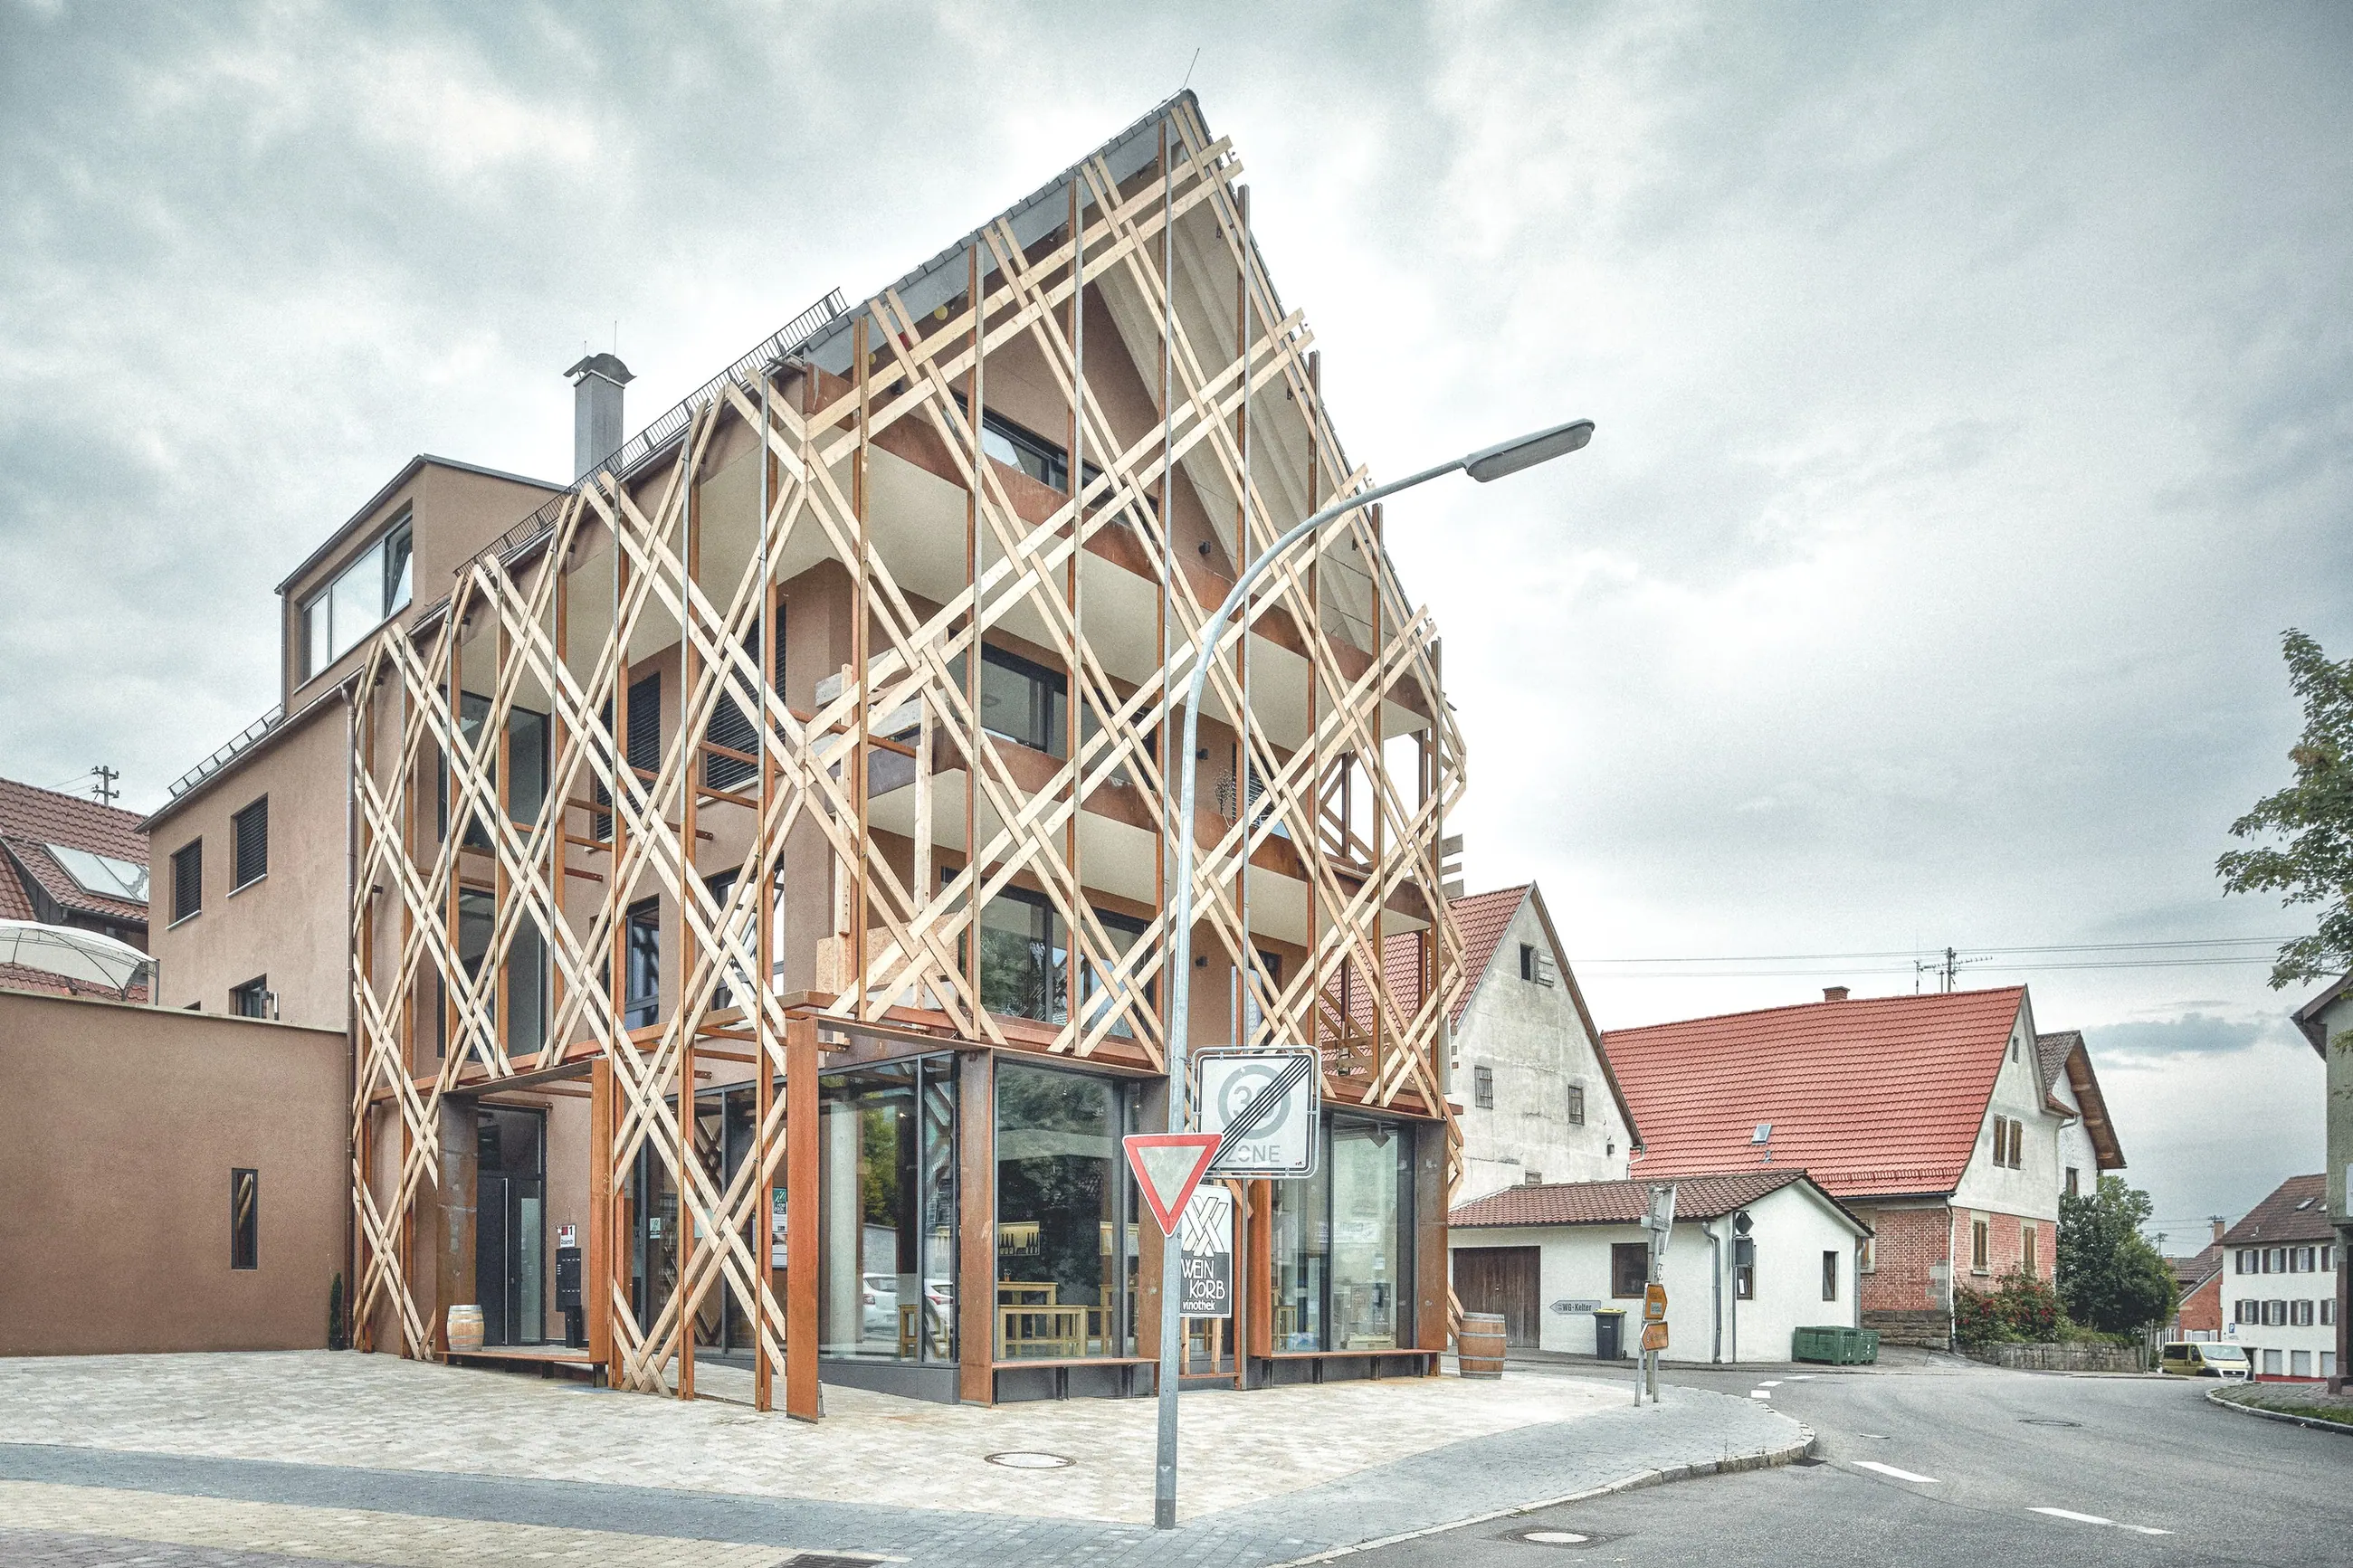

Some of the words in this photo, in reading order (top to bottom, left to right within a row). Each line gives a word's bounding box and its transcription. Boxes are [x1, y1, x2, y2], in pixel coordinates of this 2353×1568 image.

[569, 1226, 573, 1235] 1
[1181, 1259, 1215, 1278] WEIN
[1189, 1278, 1225, 1299] KORB
[1183, 1299, 1215, 1311] vinothek
